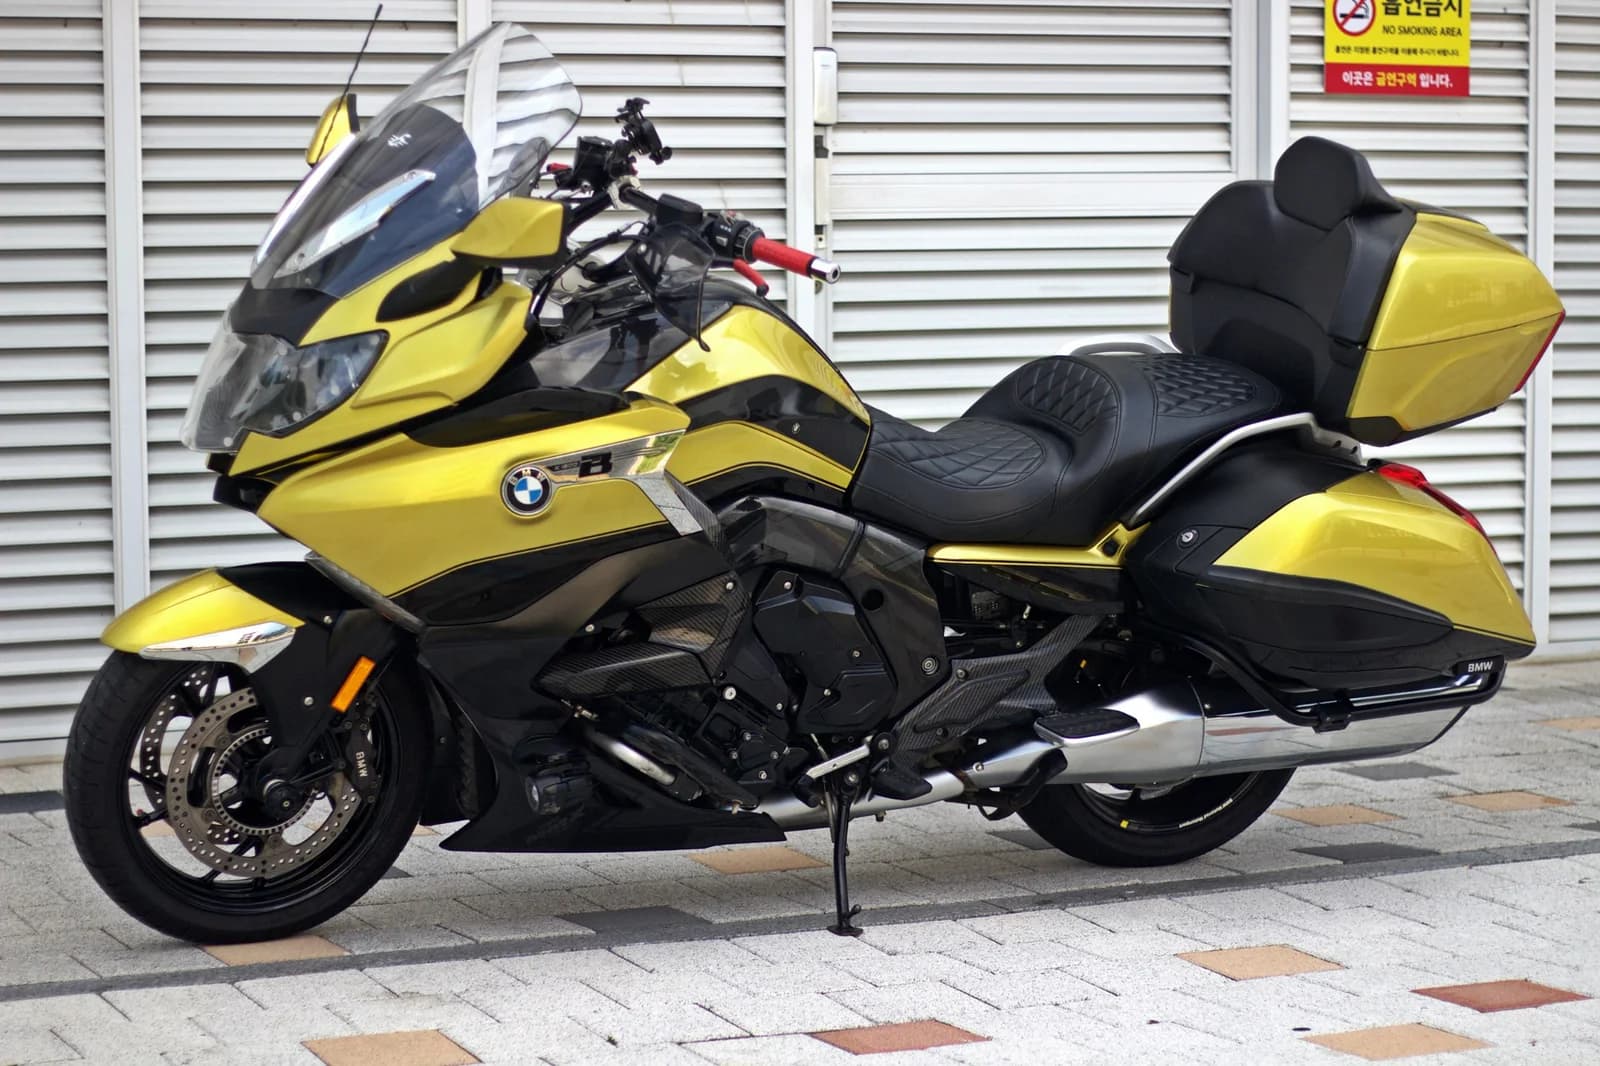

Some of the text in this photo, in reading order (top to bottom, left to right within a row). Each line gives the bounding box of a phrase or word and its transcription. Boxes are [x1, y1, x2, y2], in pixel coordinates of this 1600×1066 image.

[1383, 25, 1462, 36] NO SMOKING AREA
[1342, 71, 1453, 88] 이곳은 금연구역 입니다.
[510, 469, 545, 485] BMW
[1468, 661, 1493, 672] BMW
[355, 752, 368, 777] BMW
